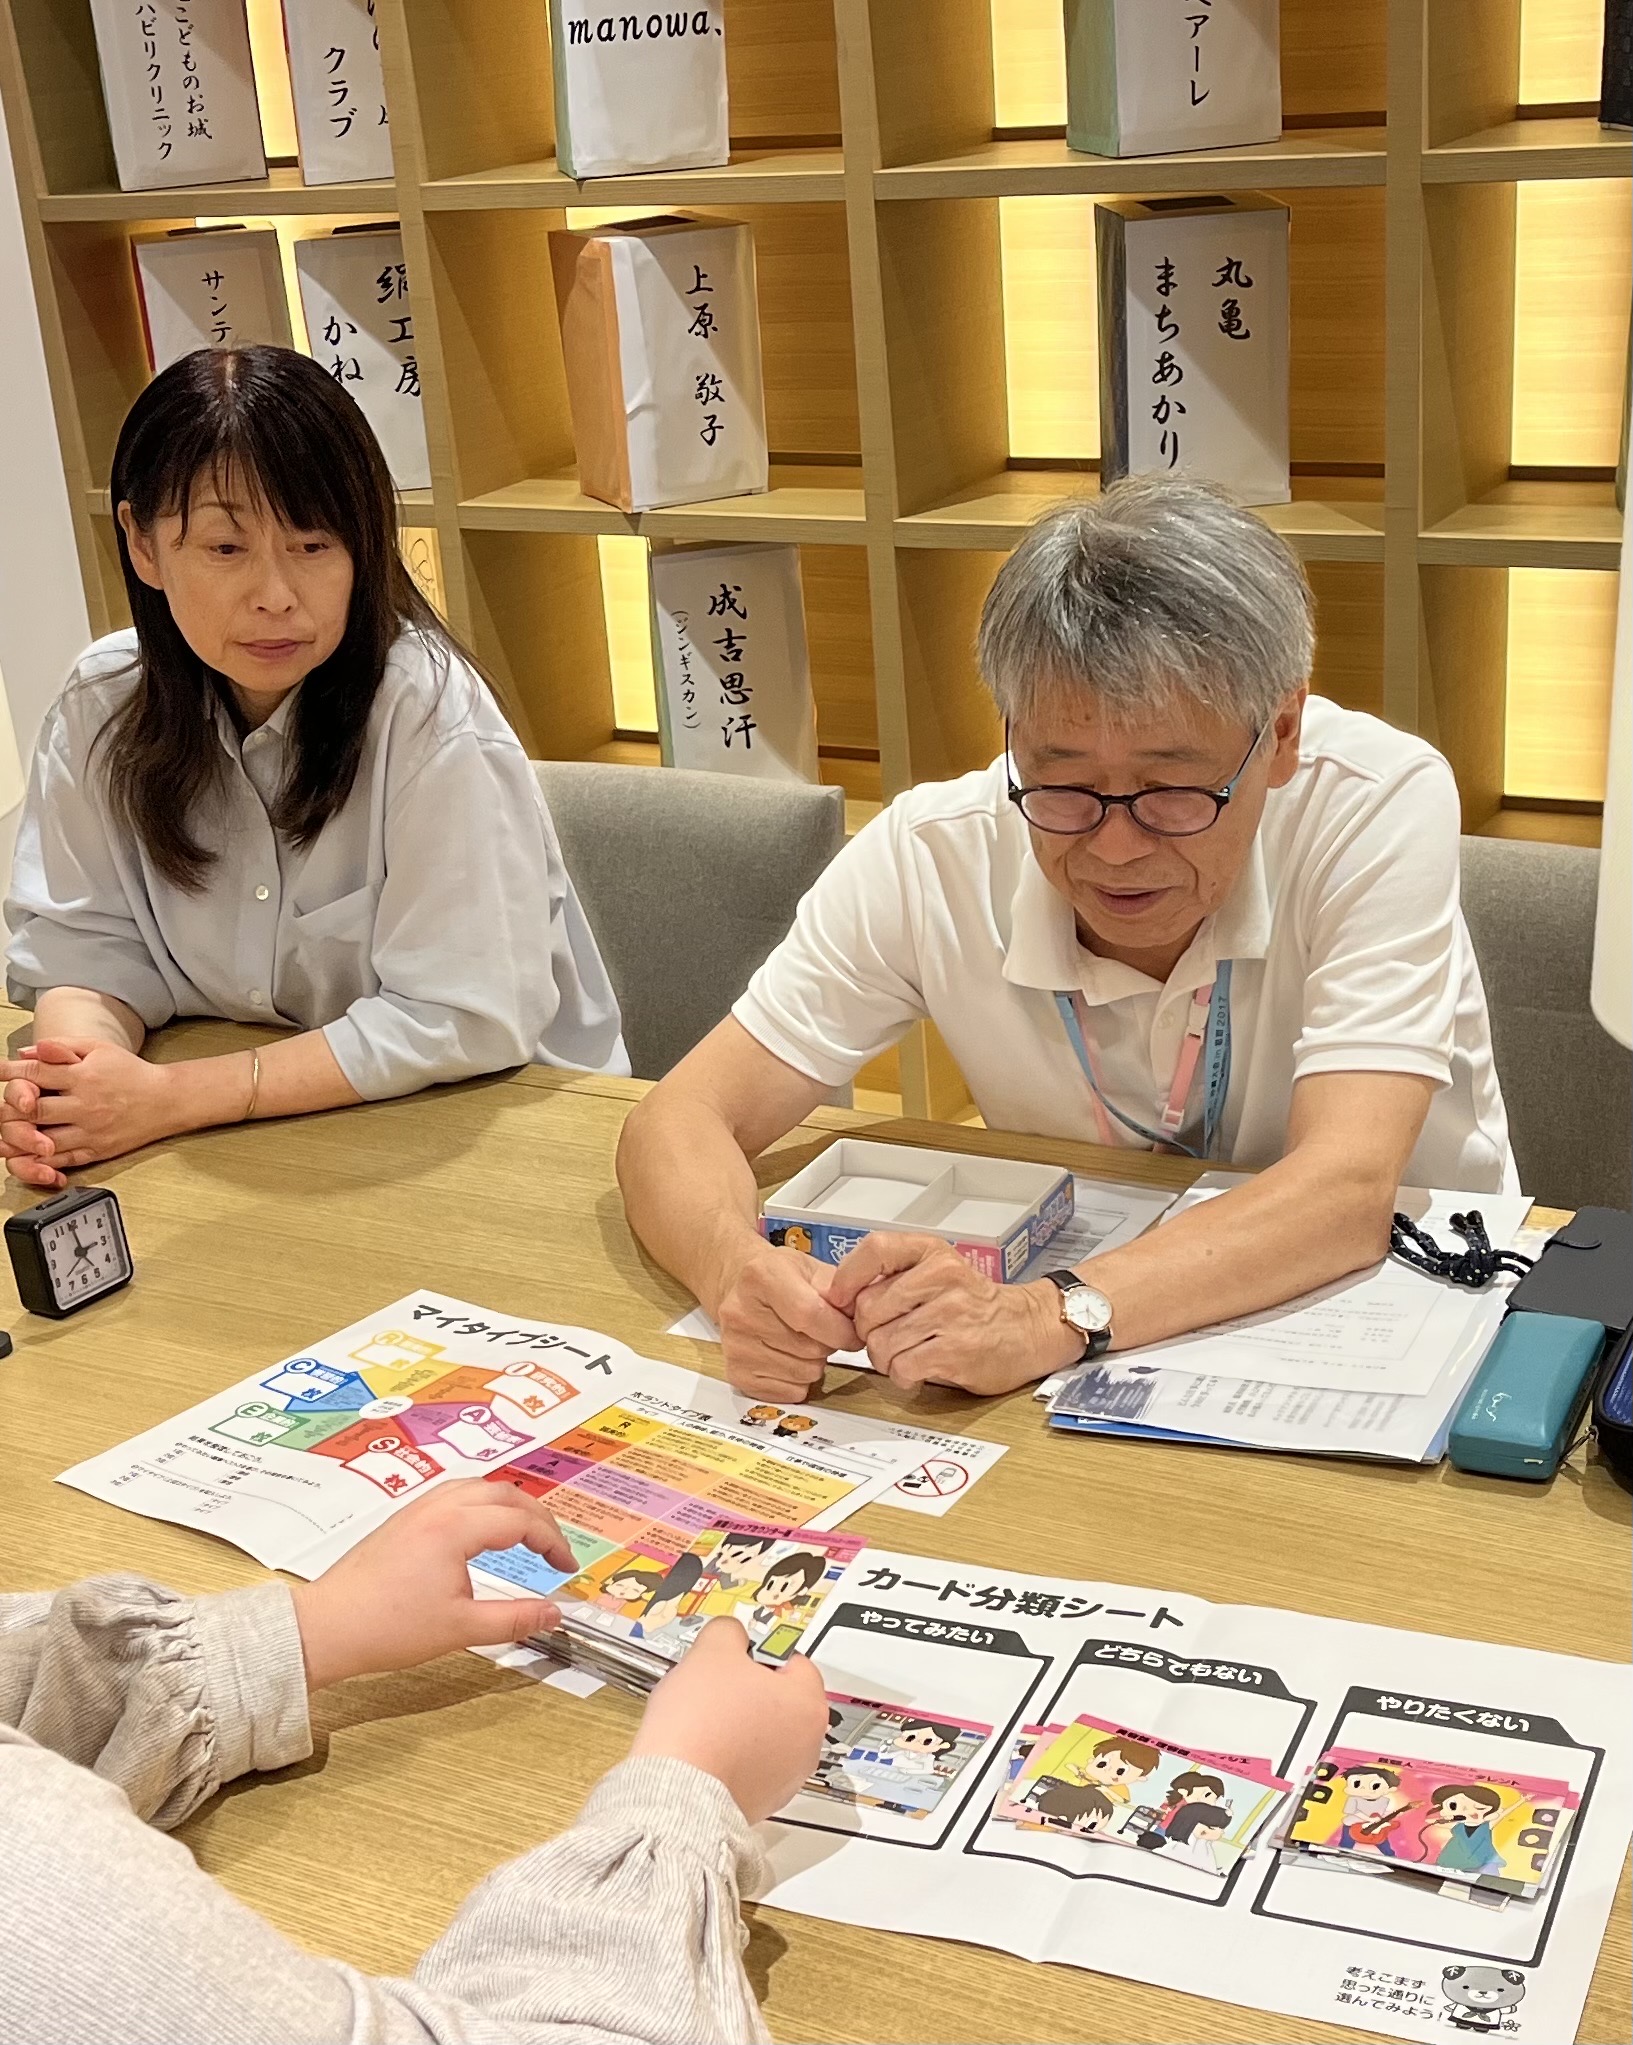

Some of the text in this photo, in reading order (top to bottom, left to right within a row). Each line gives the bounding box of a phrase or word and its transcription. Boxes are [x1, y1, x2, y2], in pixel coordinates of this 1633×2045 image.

[175, 0, 213, 140] こどものお城
[1184, 0, 1212, 106] アーレ
[324, 47, 358, 138] クラブ
[201, 270, 232, 342] サンテ
[1211, 256, 1253, 340] 丸亀
[323, 315, 364, 383] かね
[685, 265, 726, 446] 上原 敬子
[1152, 256, 1187, 469] まちあかり
[707, 583, 757, 749] 成吉思汗
[1216, 996, 1228, 1026] 2017
[54, 1226, 65, 1238] 11
[100, 1235, 107, 1246] 3
[68, 1280, 75, 1291] 7
[81, 1274, 88, 1284] 6
[94, 1268, 101, 1278] 5
[412, 1304, 613, 1376] マイタイプシート
[290, 1361, 312, 1370] C
[240, 1404, 265, 1415] E
[462, 1408, 486, 1422] A
[372, 1439, 395, 1450] S
[857, 1567, 1185, 1630] カード分類シート
[859, 1609, 996, 1646] やってみたい
[1093, 1643, 1264, 1686] どちらでもない
[1376, 1694, 1532, 1735] やりたくない
[1339, 1978, 1436, 2007] 思った通りに
